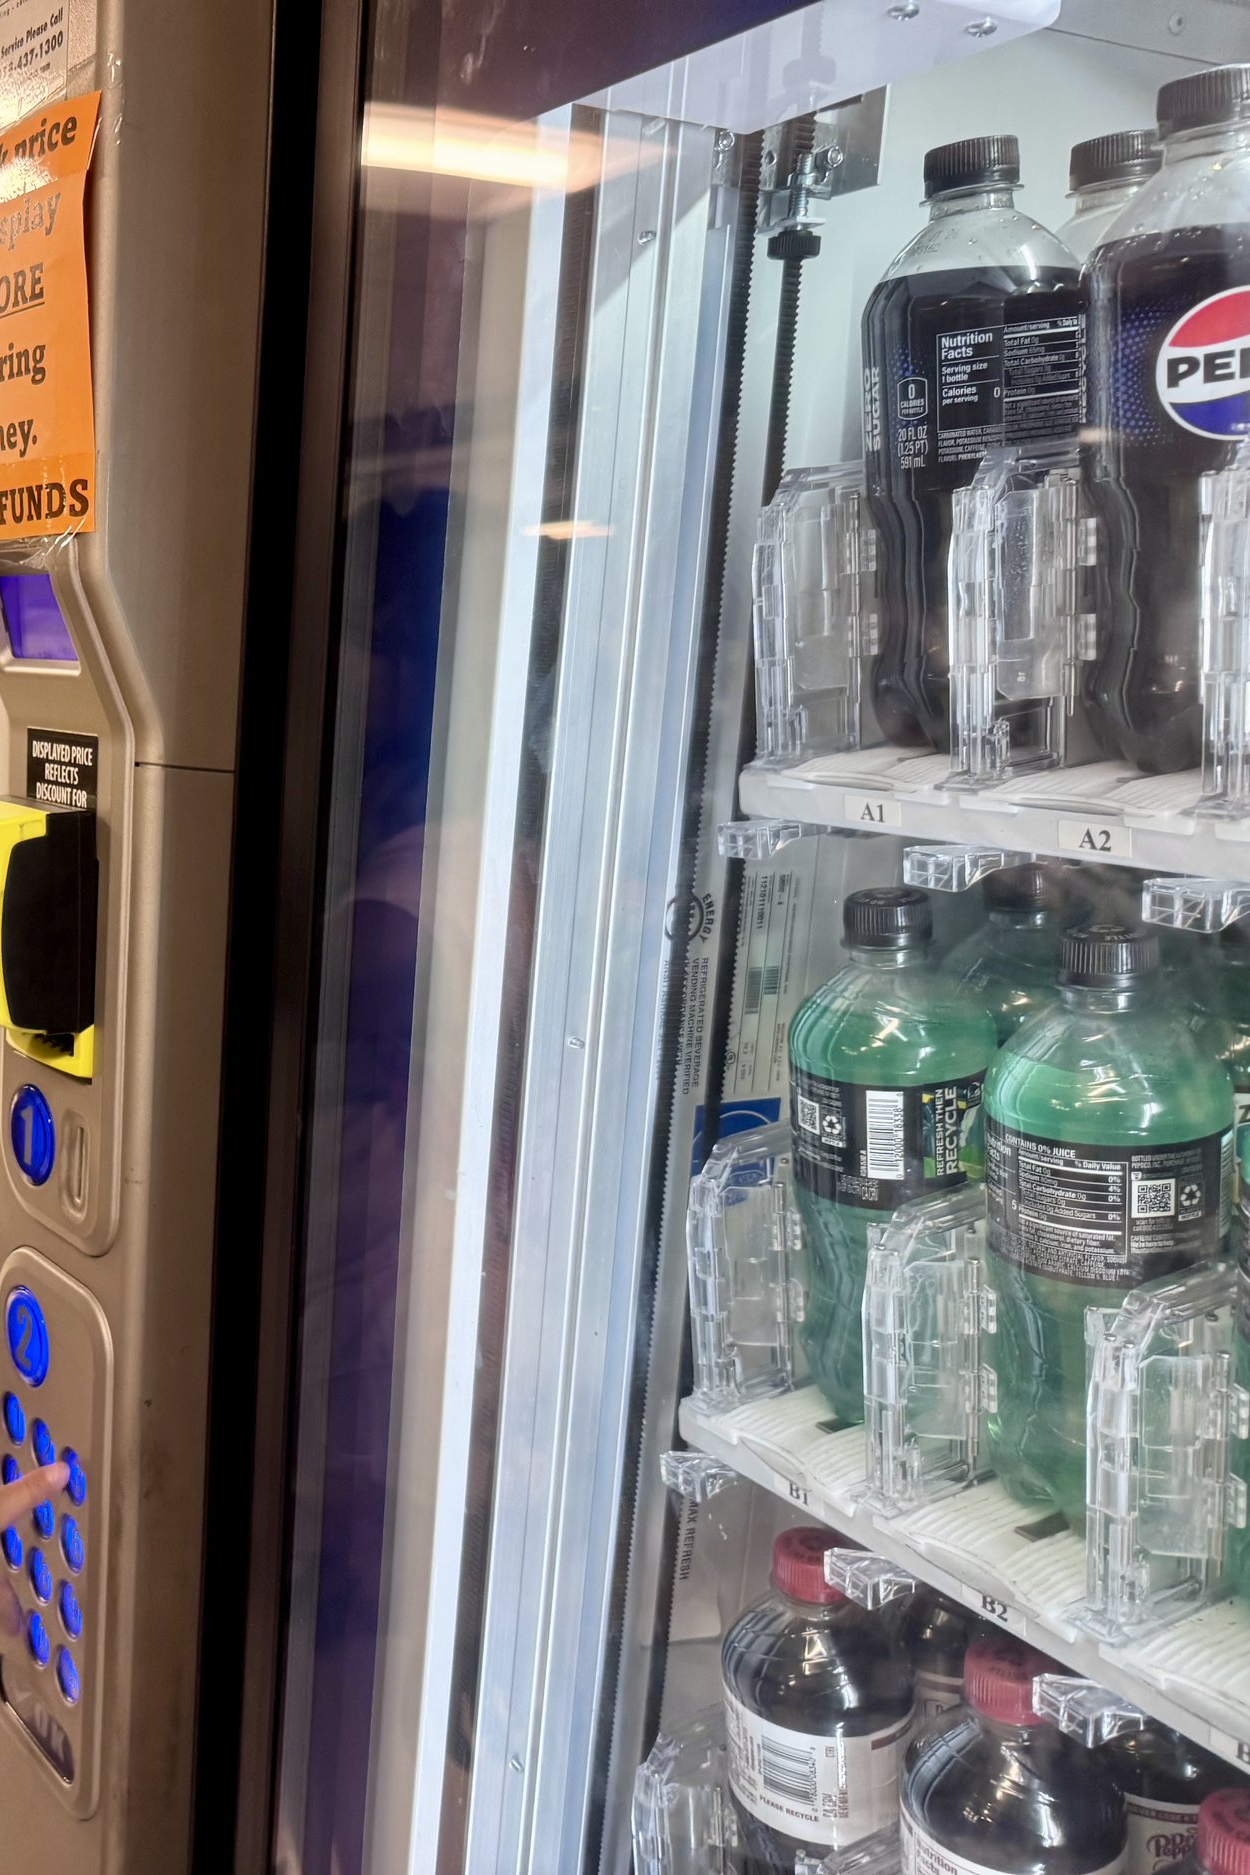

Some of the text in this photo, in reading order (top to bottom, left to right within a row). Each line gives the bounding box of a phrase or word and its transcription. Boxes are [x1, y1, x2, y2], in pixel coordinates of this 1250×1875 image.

[1, 37, 24, 58] Service
[26, 22, 48, 43] Please
[50, 6, 64, 27] Call
[14, 116, 78, 160] price
[941, 331, 993, 348] Nutrition
[1004, 339, 1019, 347] Total
[941, 347, 973, 360] Facts
[941, 361, 988, 375] Serving size
[946, 373, 969, 383] bottle
[908, 383, 916, 399] 0
[942, 386, 1001, 398] Calories 0
[942, 394, 979, 406] per serving
[864, 367, 873, 452] ZERO
[872, 366, 881, 452] SUGAR
[900, 399, 925, 409] CALORIES
[898, 424, 928, 442] 20 FL OZ
[915, 440, 929, 455] PT)
[900, 455, 926, 470] 591 mL
[32, 740, 93, 766] DISPLAYED PRICE
[44, 763, 79, 785] REFLECTS
[36, 782, 87, 809] DISCOUNT FOR
[860, 802, 885, 823] A1
[1078, 828, 1112, 852] A2
[699, 892, 715, 945] ENERGY
[682, 957, 699, 1096] VENDING MACHINE VERIFIED
[691, 957, 709, 1088] REFRIGERATED BEVERAGE
[20, 1105, 34, 1166] 1
[935, 1088, 945, 1176] REFRESH THEN
[945, 1086, 958, 1175] RECYCLE
[893, 1137, 903, 1163] 12000
[1005, 1134, 1076, 1159] CONTAINS 0% JUICE
[1032, 1164, 1042, 1173] Fat
[1108, 1175, 1121, 1184] 0%
[1083, 1161, 1100, 1170] Daily
[1101, 1161, 1121, 1171] Value
[1032, 1183, 1076, 1199] Carbohydrate
[1108, 1195, 1121, 1203] 0%
[1108, 1185, 1121, 1193] 4%
[1011, 1199, 1017, 1210] 5
[1054, 1207, 1074, 1217] Added
[1074, 1209, 1096, 1219] Sugars
[1108, 1213, 1121, 1221] 0%
[17, 1305, 33, 1369] 2
[789, 1480, 809, 1506] B1
[679, 1528, 696, 1581] REFRESH
[981, 1593, 1008, 1622] B2
[1237, 1740, 1250, 1766] B
[759, 1794, 819, 1822] PLEASE RECYCLE
